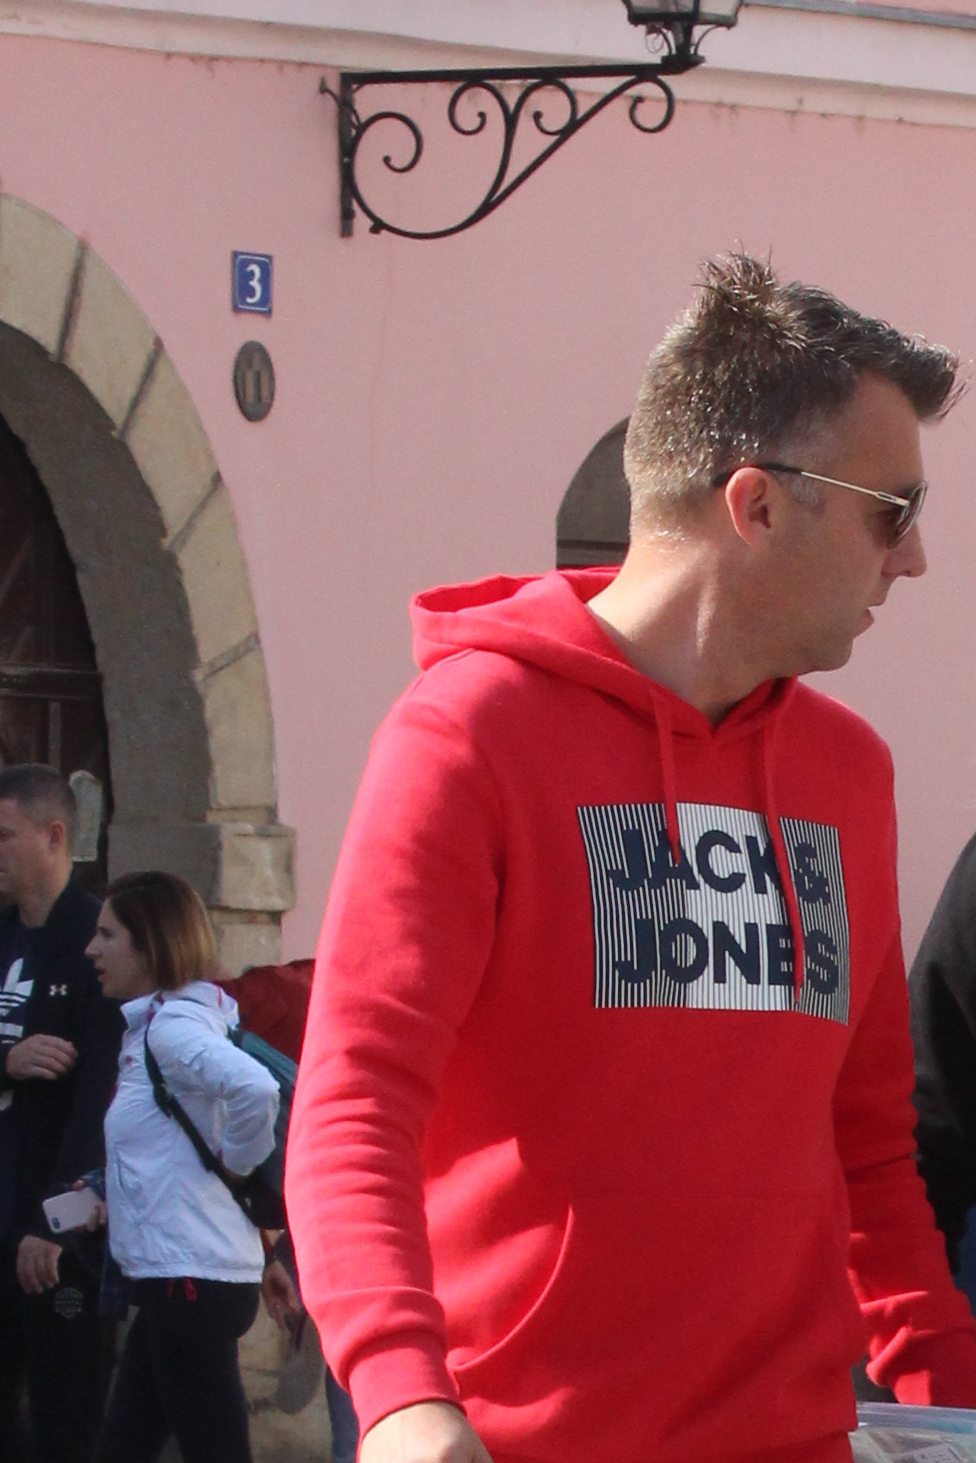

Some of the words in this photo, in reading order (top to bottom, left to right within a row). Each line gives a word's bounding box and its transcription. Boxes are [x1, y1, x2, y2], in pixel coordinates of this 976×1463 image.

[245, 263, 263, 304] 3
[608, 827, 785, 895] JACK
[794, 841, 831, 904] &
[614, 916, 839, 995] JONES
